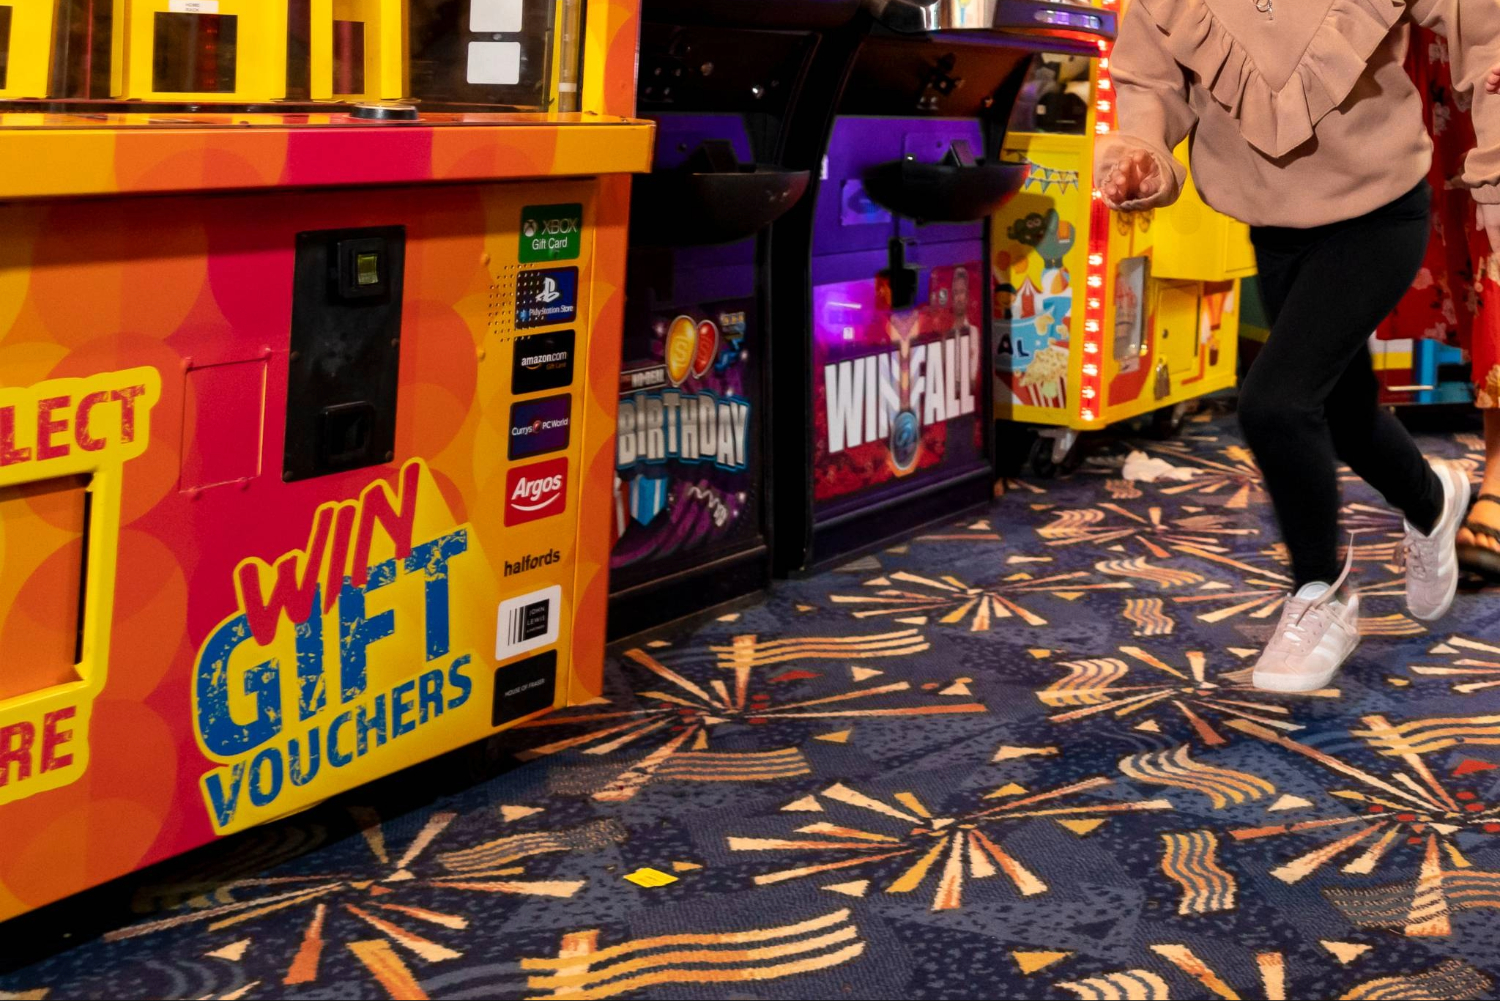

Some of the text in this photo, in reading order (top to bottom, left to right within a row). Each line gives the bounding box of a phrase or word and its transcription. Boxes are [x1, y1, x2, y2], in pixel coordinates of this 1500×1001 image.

[541, 217, 578, 235] XBOX
[532, 236, 568, 251] Gift Card
[560, 304, 574, 314] Store
[511, 417, 569, 436] Currys PC World
[618, 391, 749, 468] BIRTHDAY
[511, 474, 563, 502] Argos
[238, 462, 420, 646] WIN
[503, 548, 561, 577] halfords
[197, 528, 468, 757] GIFT
[205, 654, 472, 828] VOUCHERS
